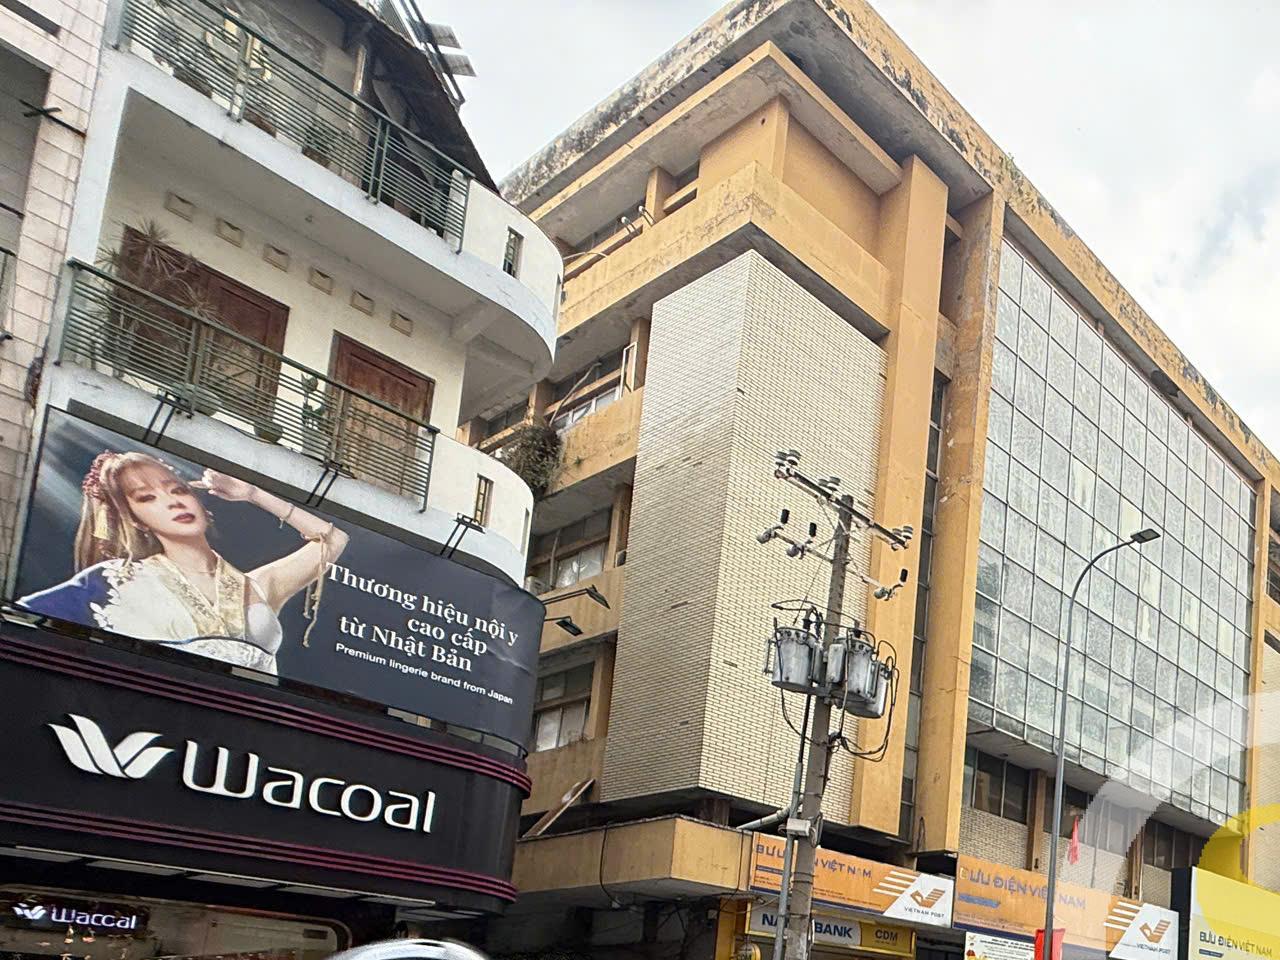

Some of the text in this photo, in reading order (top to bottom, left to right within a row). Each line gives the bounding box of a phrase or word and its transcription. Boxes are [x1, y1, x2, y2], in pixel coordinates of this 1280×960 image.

[326, 562, 519, 646] Thương hiệu nội y
[339, 615, 472, 673] từ Nhật Bản
[407, 617, 488, 656] cao cấp
[335, 642, 513, 705] Premium lingerie brand from Japan
[181, 740, 437, 834] Wacoal
[757, 844, 872, 879] BƯU VIỆT NM
[960, 866, 1086, 910] ƯU ĐIỆN VIỆ NAM
[50, 906, 138, 931] Wacoal
[814, 921, 853, 939] BANK
[904, 906, 945, 919] VIETNAM POST
[875, 928, 898, 942] CDM
[1200, 930, 1216, 945] BƯU
[1218, 934, 1238, 950] ĐIỆN
[1240, 939, 1255, 953] VIỆT
[1256, 945, 1273, 958] NAM
